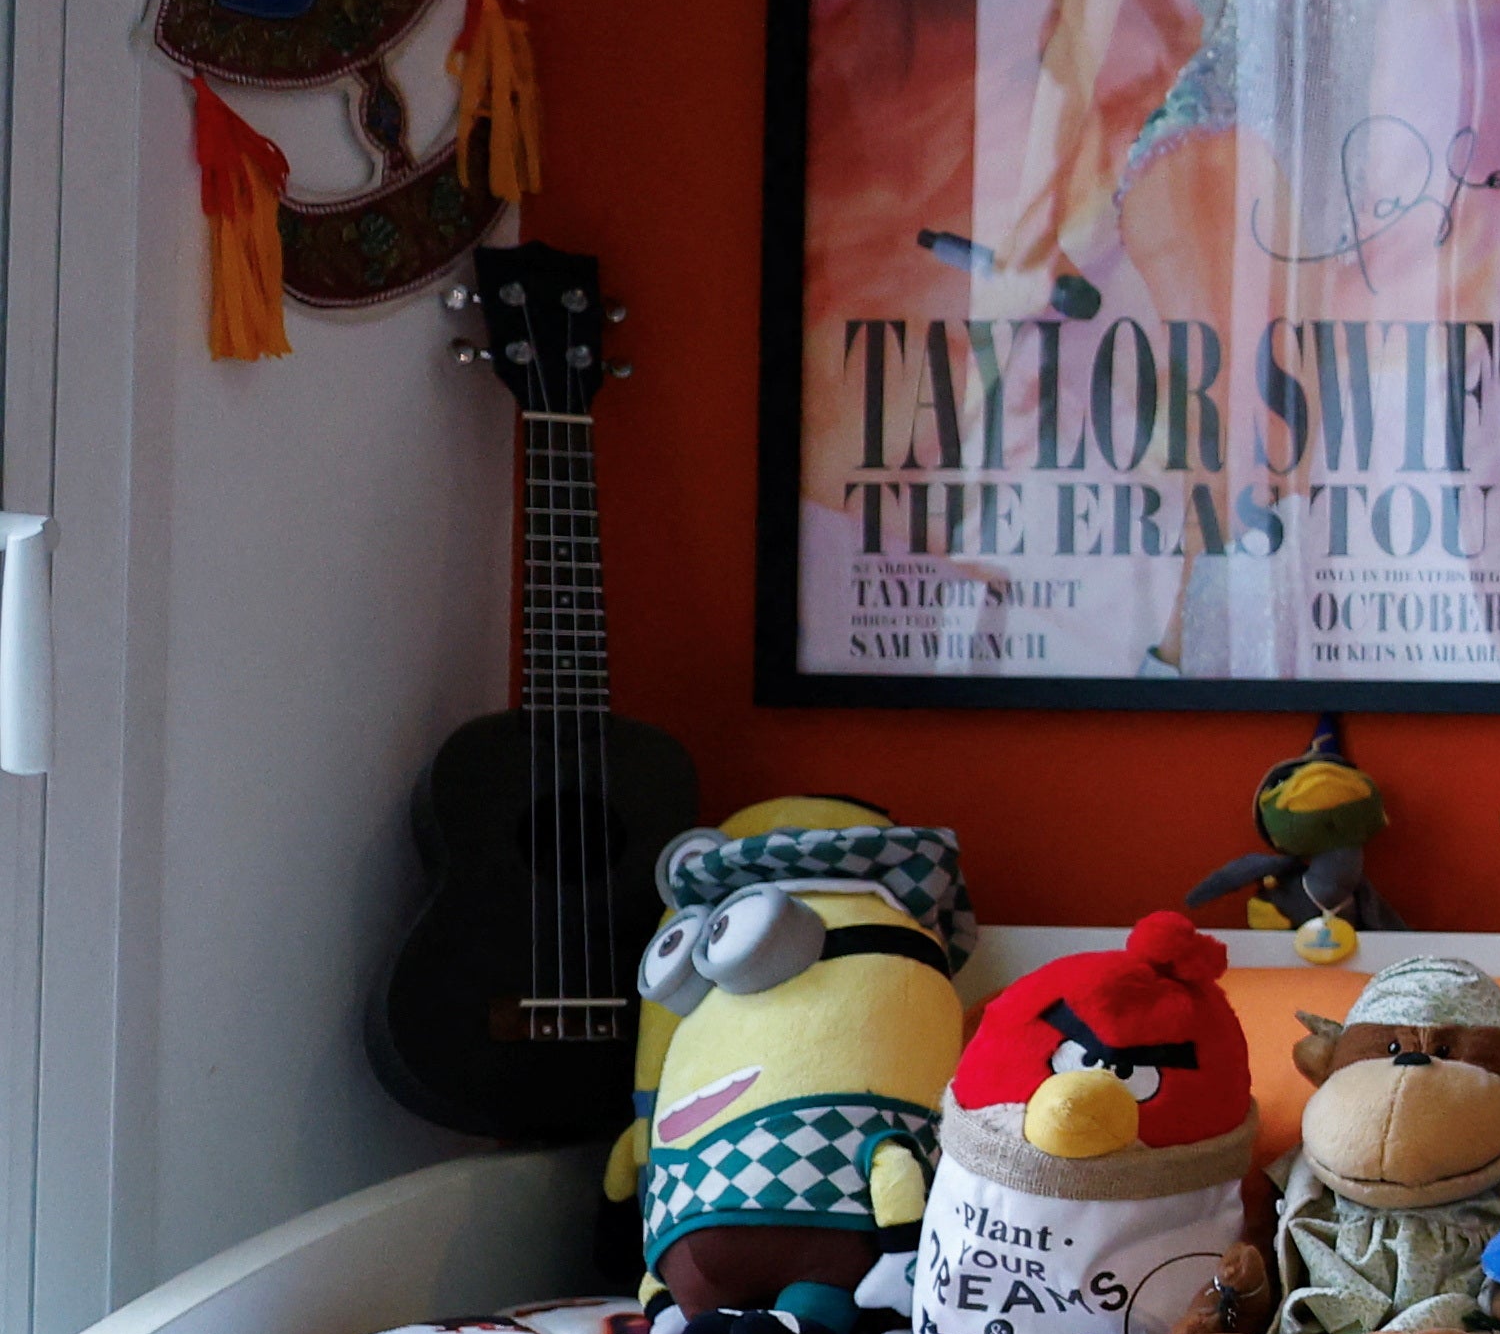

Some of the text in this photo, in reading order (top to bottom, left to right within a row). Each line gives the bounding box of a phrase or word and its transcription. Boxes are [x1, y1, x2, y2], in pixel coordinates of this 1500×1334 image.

[844, 319, 1224, 473] TAYLOR
[844, 482, 1024, 557] THE
[1055, 482, 1285, 557] ERAS
[851, 578, 1082, 608] TAYLOR SWIFT
[849, 633, 1047, 660] SAM WRENCH
[1312, 643, 1396, 663] TICKETS
[963, 1202, 1052, 1252] Plant
[958, 1240, 1046, 1281] YOUR
